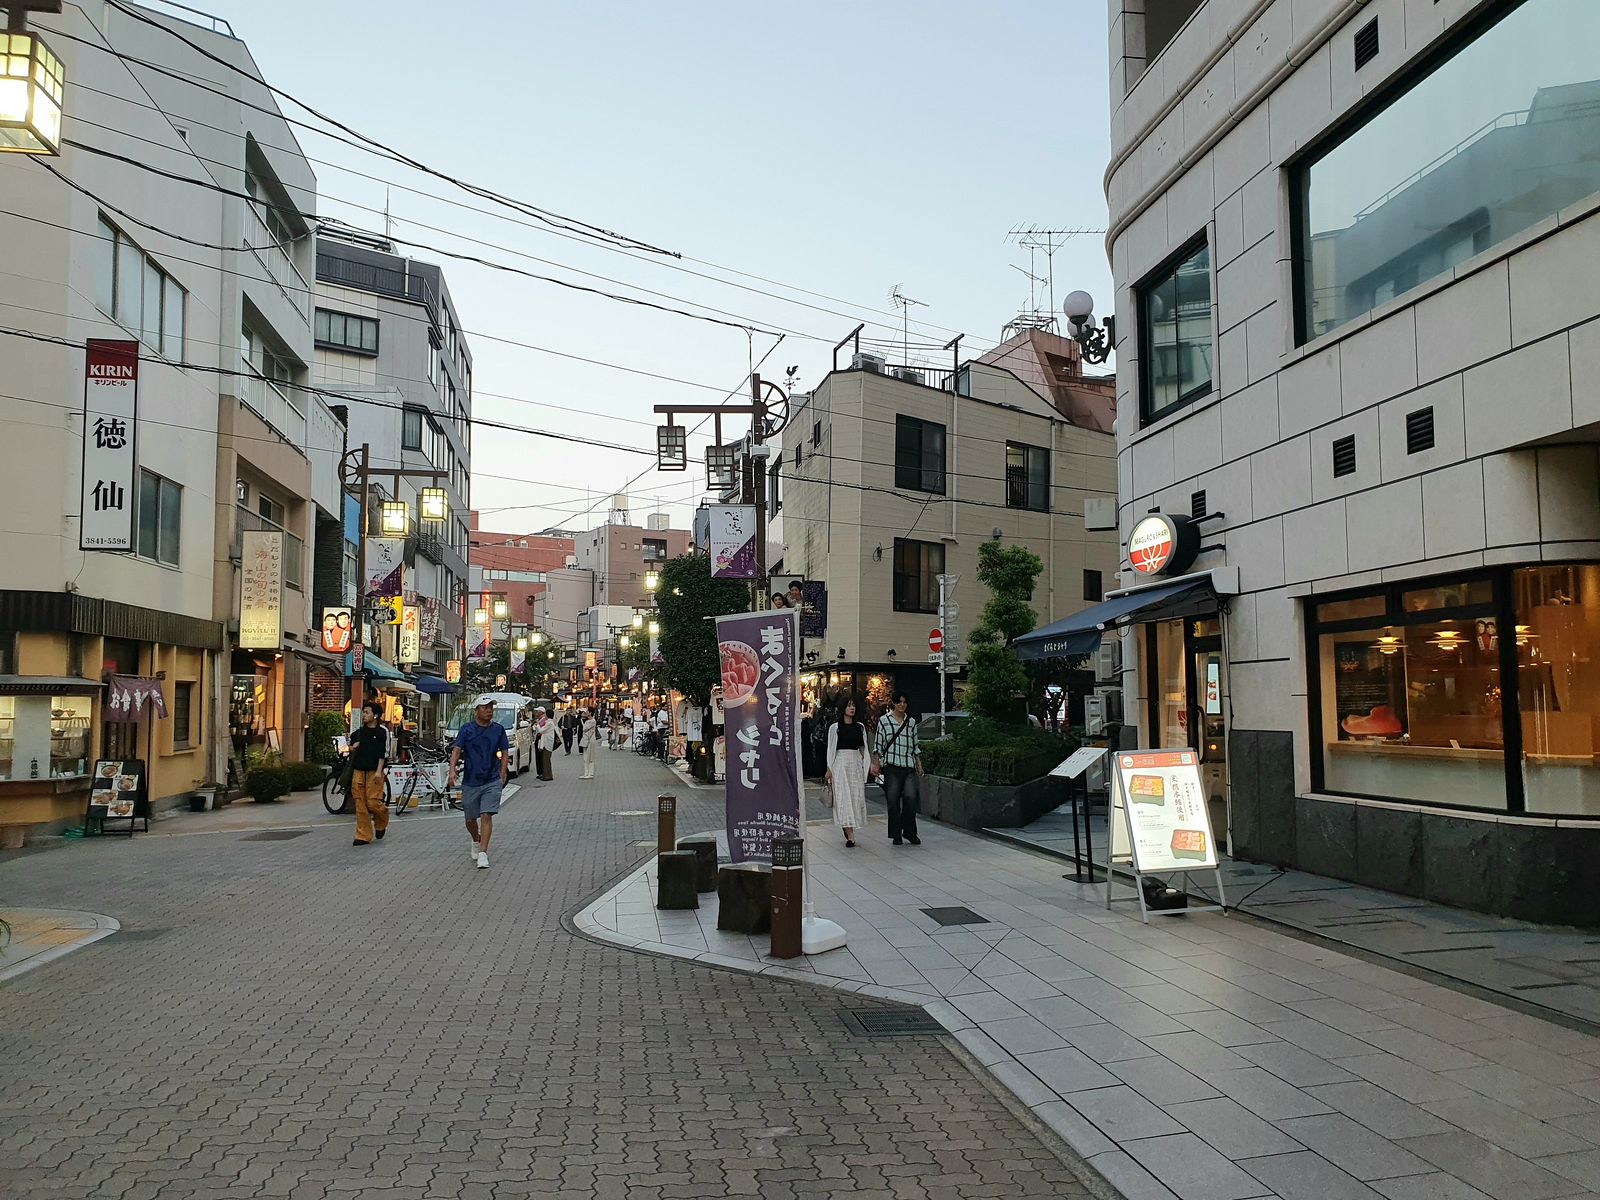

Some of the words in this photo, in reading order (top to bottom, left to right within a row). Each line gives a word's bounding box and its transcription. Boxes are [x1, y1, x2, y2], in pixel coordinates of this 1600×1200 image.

[90, 364, 133, 377] KIRIN
[94, 379, 128, 387] キリンビール
[90, 417, 127, 511] 徳仙
